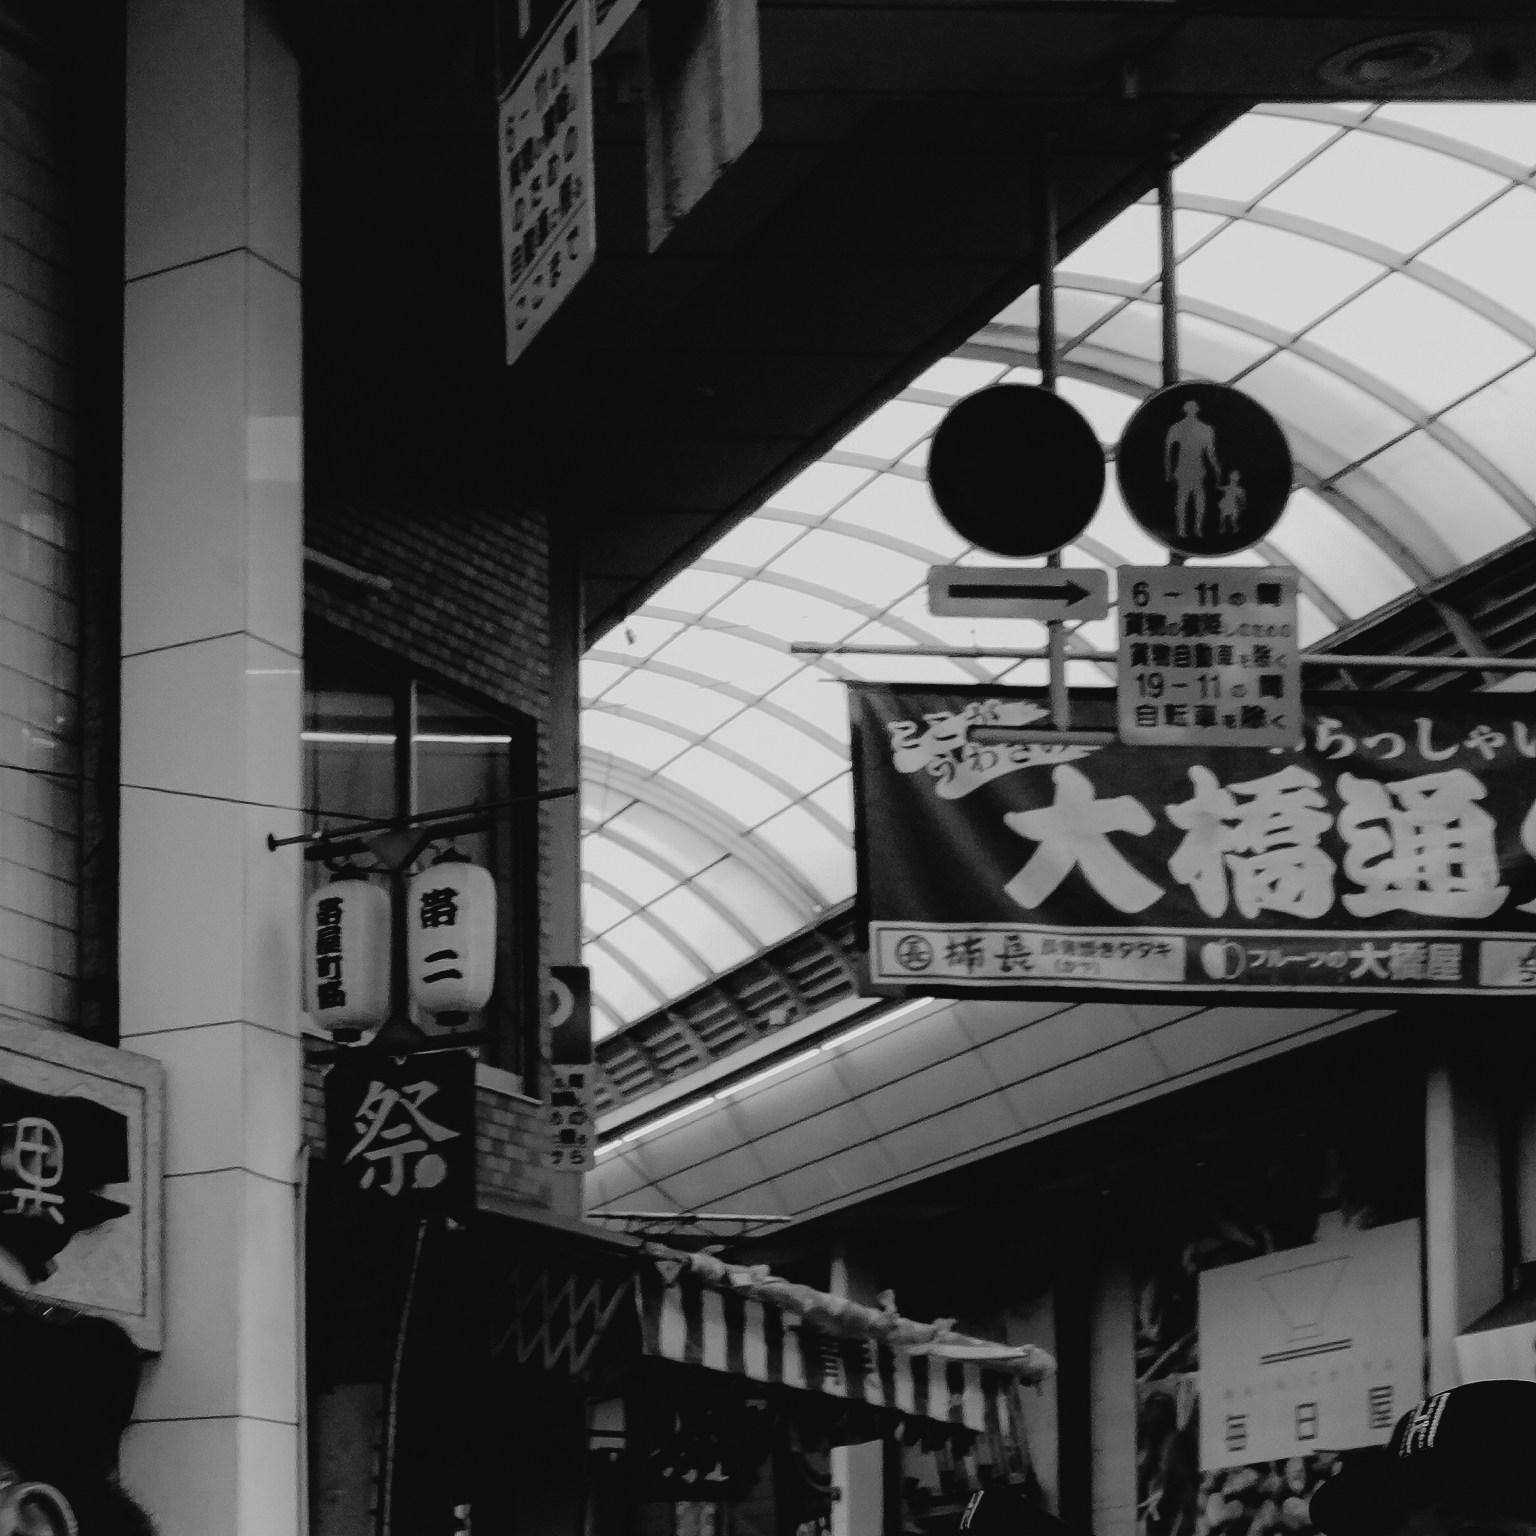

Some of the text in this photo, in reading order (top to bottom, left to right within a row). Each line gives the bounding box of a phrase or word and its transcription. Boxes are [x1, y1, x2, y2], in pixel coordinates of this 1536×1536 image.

[1001, 763, 1536, 922] 大橋通
[342, 1079, 462, 1197] 祭
